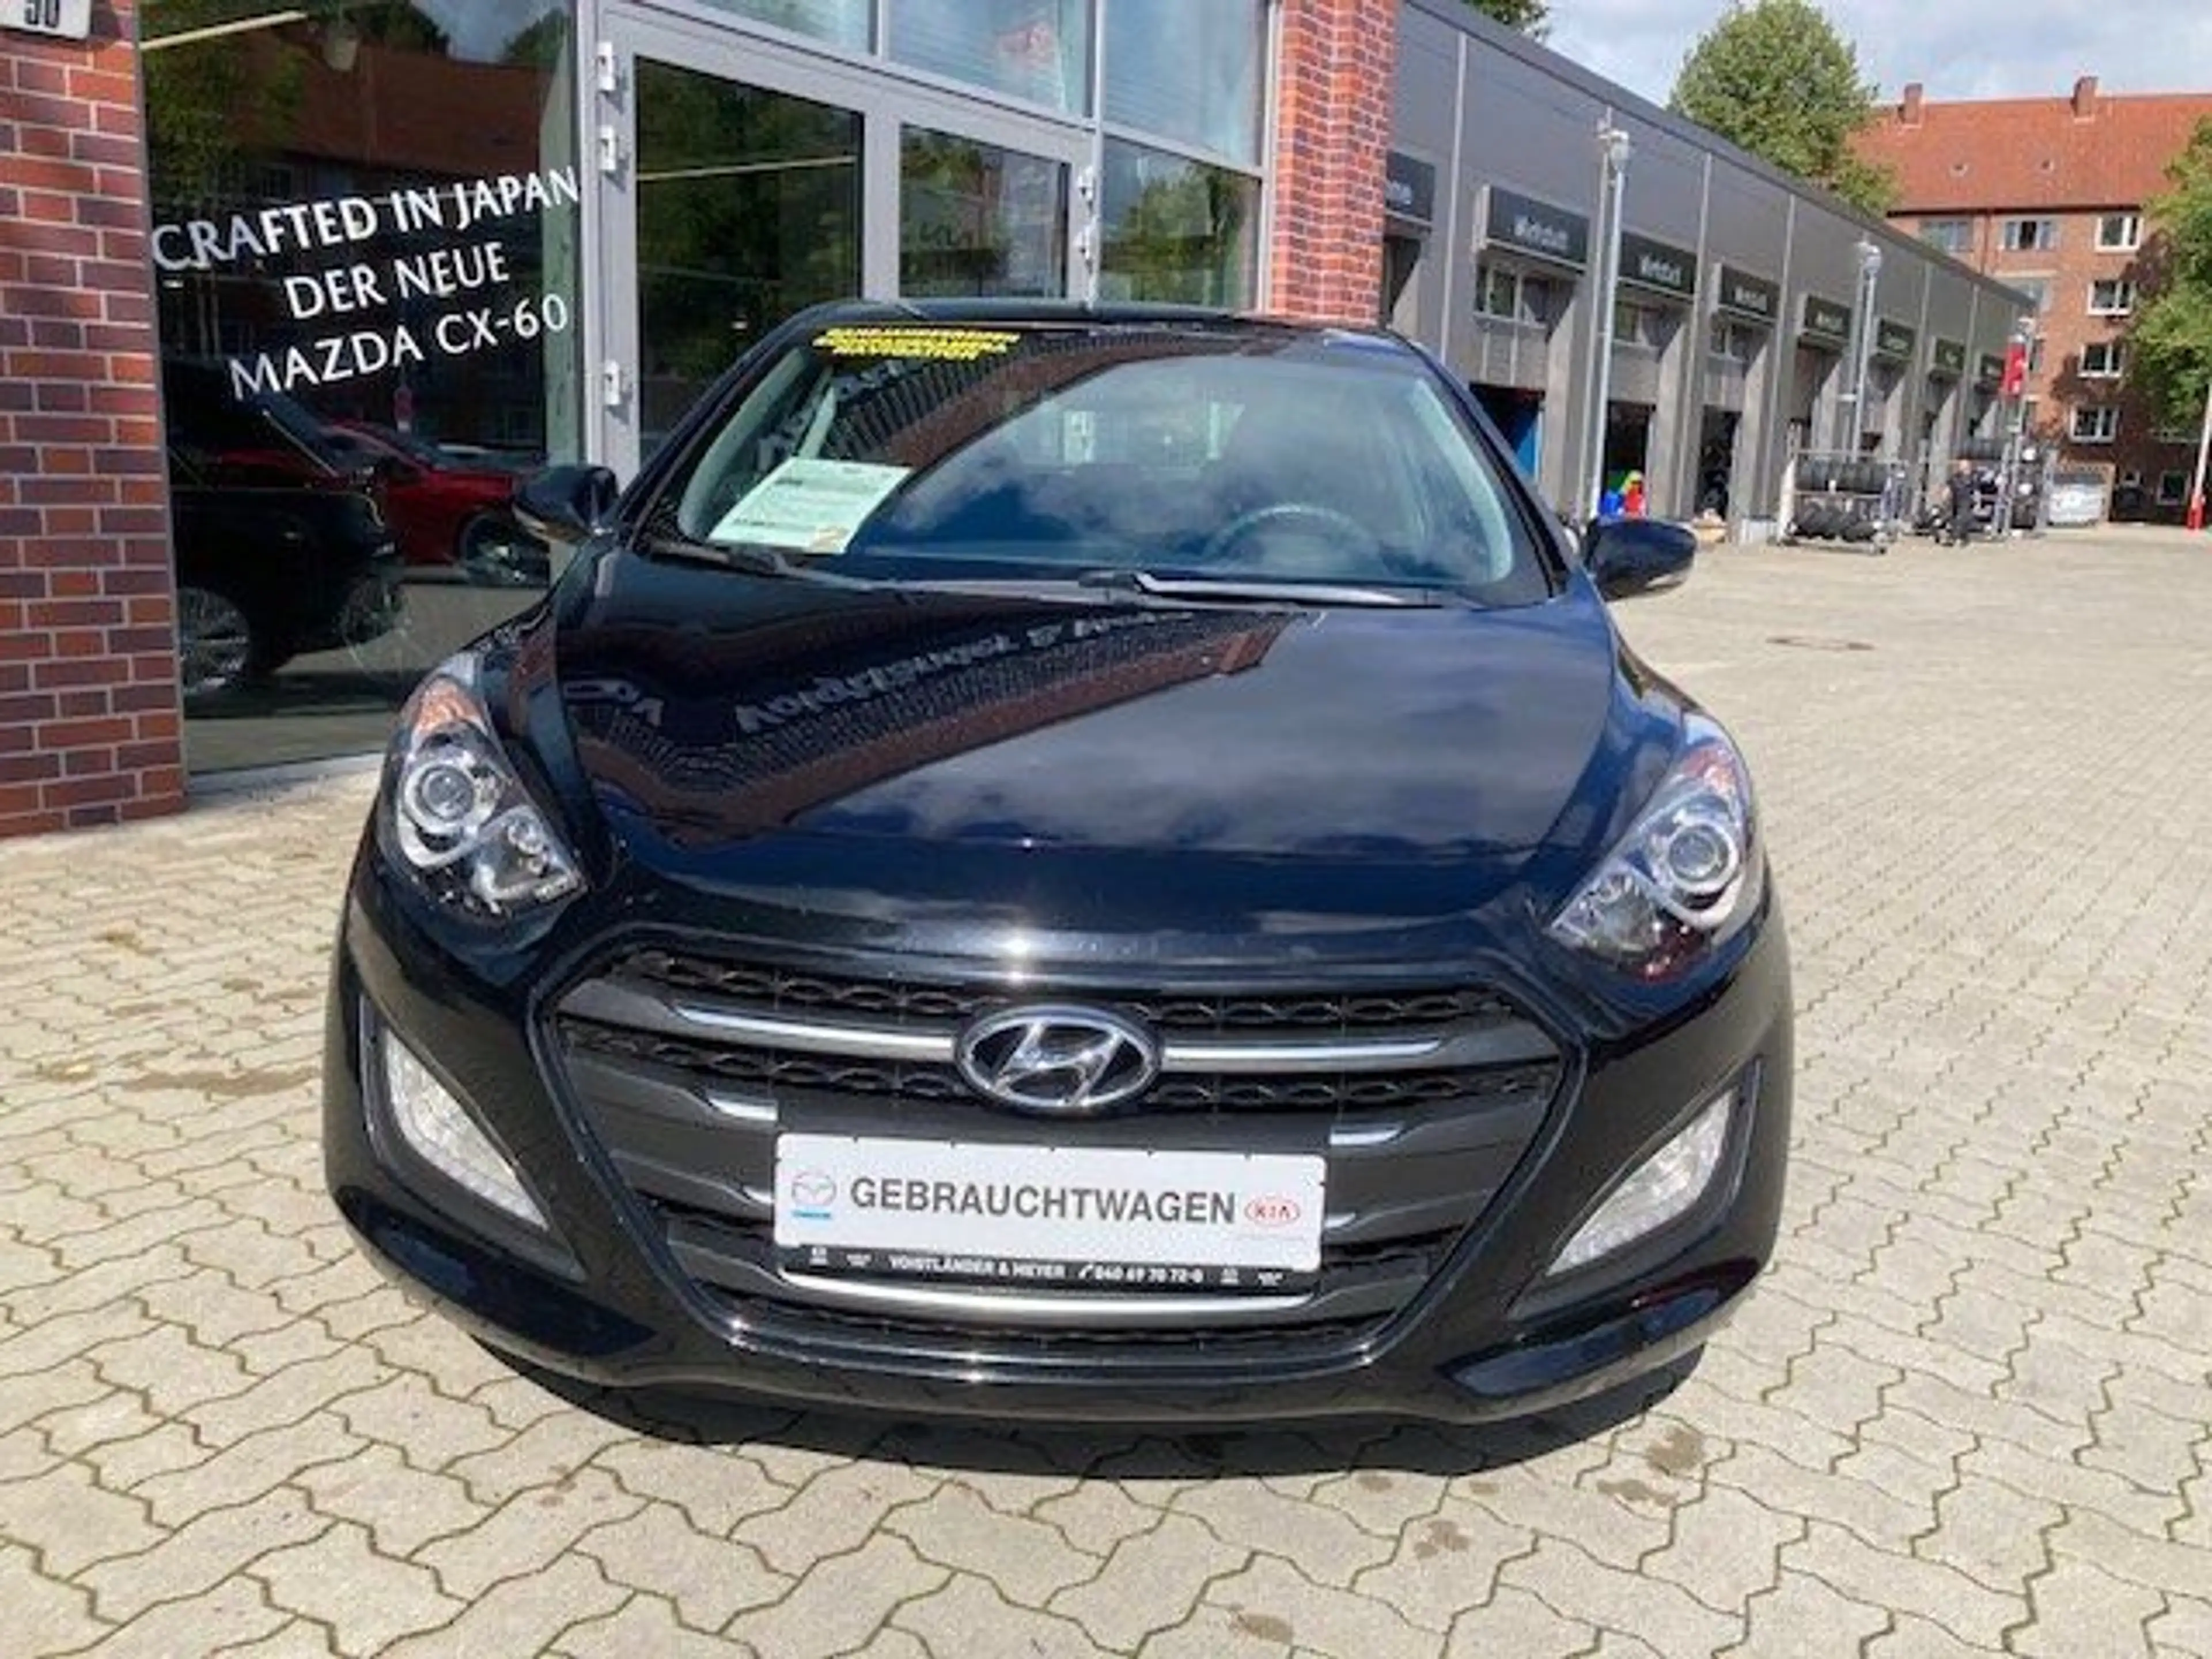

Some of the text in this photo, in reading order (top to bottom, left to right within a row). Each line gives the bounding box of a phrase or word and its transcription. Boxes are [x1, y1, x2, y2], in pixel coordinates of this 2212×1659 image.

[153, 166, 580, 272] CRAFTED IN JAPAN
[285, 242, 510, 320] DER NEUE
[229, 293, 568, 402] MAZDA CX-60
[850, 1177, 1236, 1225] GEBRAUCHTWAGEN
